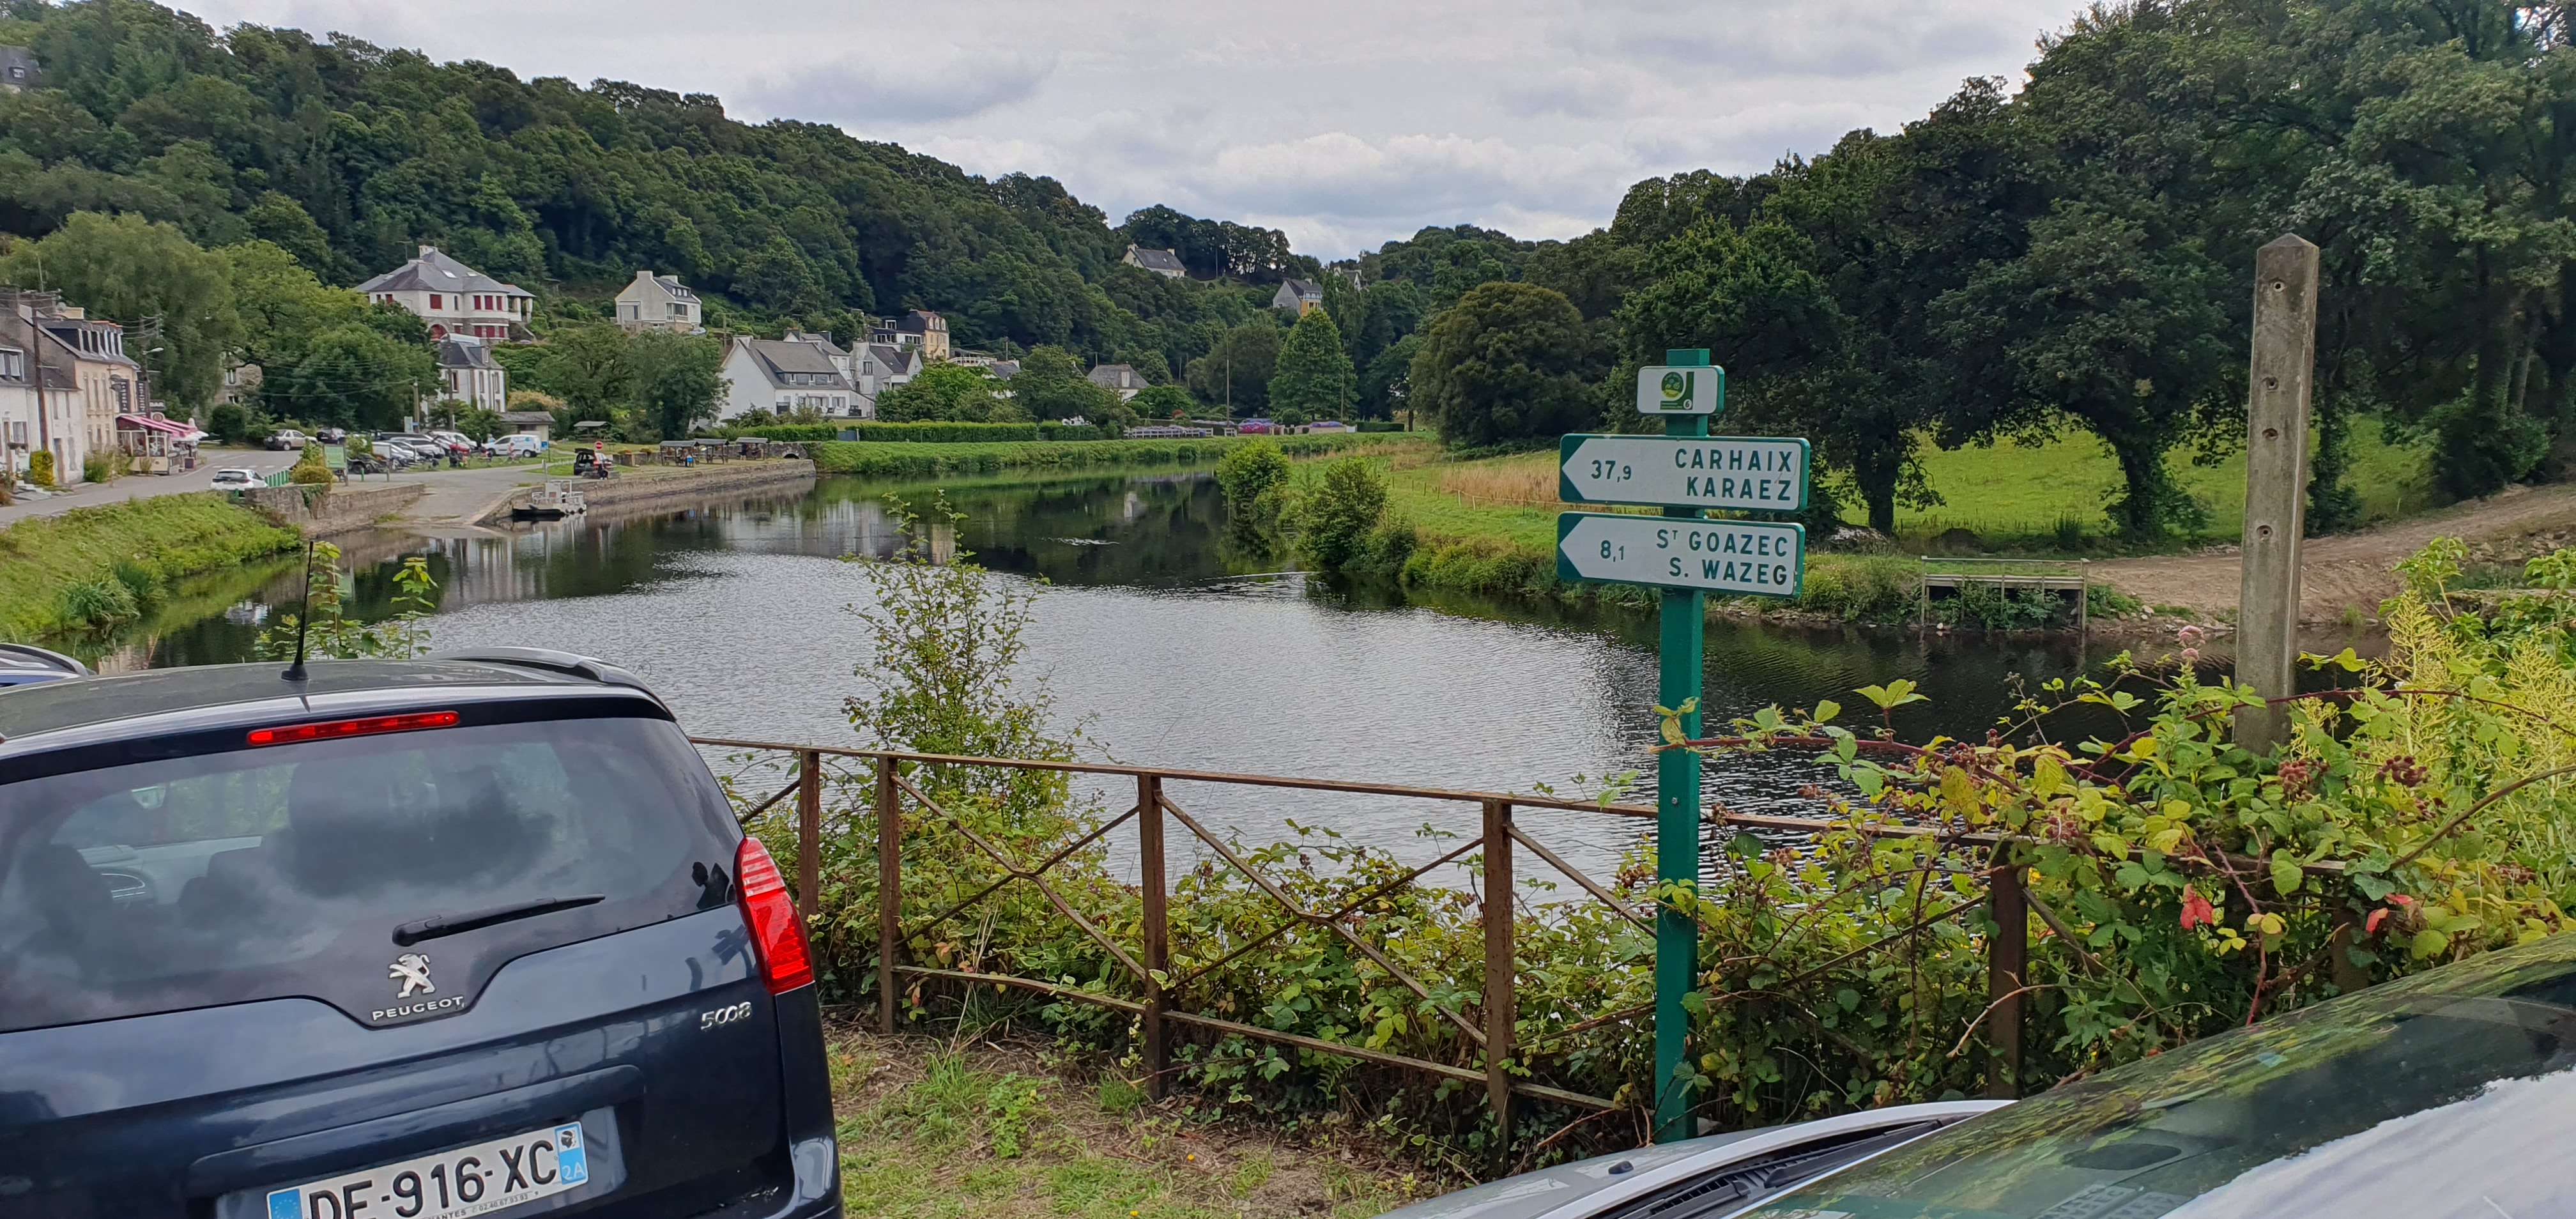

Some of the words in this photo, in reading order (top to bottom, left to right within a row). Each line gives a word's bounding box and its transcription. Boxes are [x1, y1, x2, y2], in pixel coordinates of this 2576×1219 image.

[1591, 460, 1632, 483] 37,9
[1675, 448, 1793, 472] CARHAIX
[1686, 477, 1791, 500] KARAEZ
[1600, 540, 1625, 562] 8,1
[1689, 531, 1788, 556] GOAZEC
[1669, 557, 1689, 578] S.
[1701, 559, 1787, 585] WAZEG
[372, 995, 464, 1021] PEUGEOT
[700, 1001, 751, 1031] 5008
[309, 1140, 557, 1219] DE-916-XC
[562, 1162, 586, 1181] 2A
